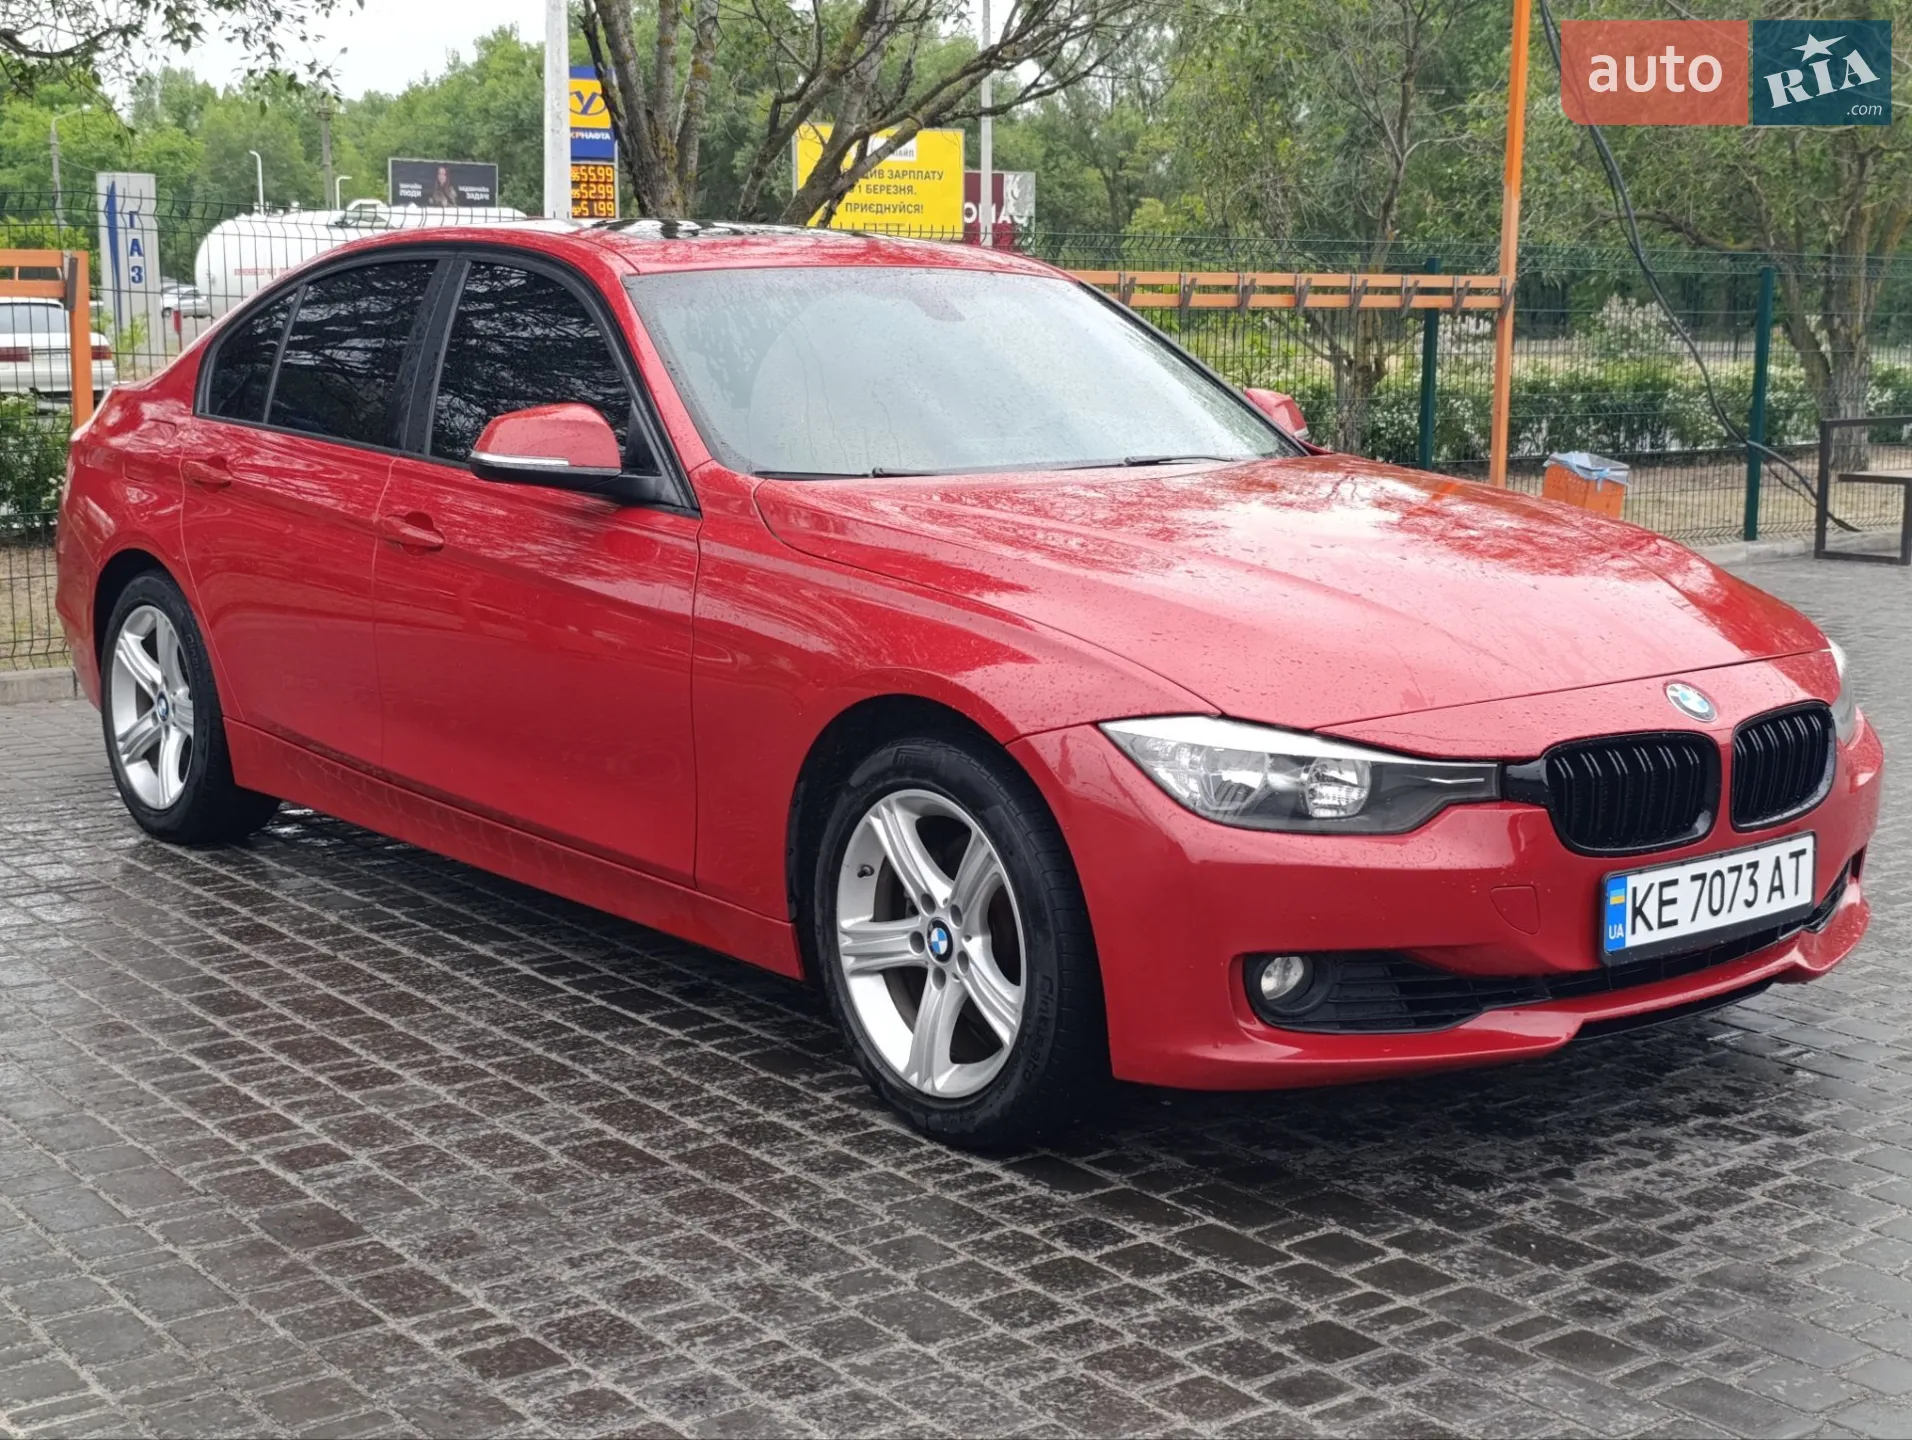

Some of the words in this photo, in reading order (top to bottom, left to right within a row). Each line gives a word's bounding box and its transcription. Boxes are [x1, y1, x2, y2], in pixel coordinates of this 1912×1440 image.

[570, 132, 610, 140] КРНАФТА
[887, 169, 944, 181] ЗАРПЛАТУ
[866, 184, 917, 196] БЕРЕЗНЯ.
[845, 201, 924, 215] ПРИЄДНУЙСЯ!
[1631, 878, 1679, 935] KE
[1690, 860, 1760, 923] 7073
[1766, 848, 1807, 903] AT
[1608, 924, 1625, 940] UA
